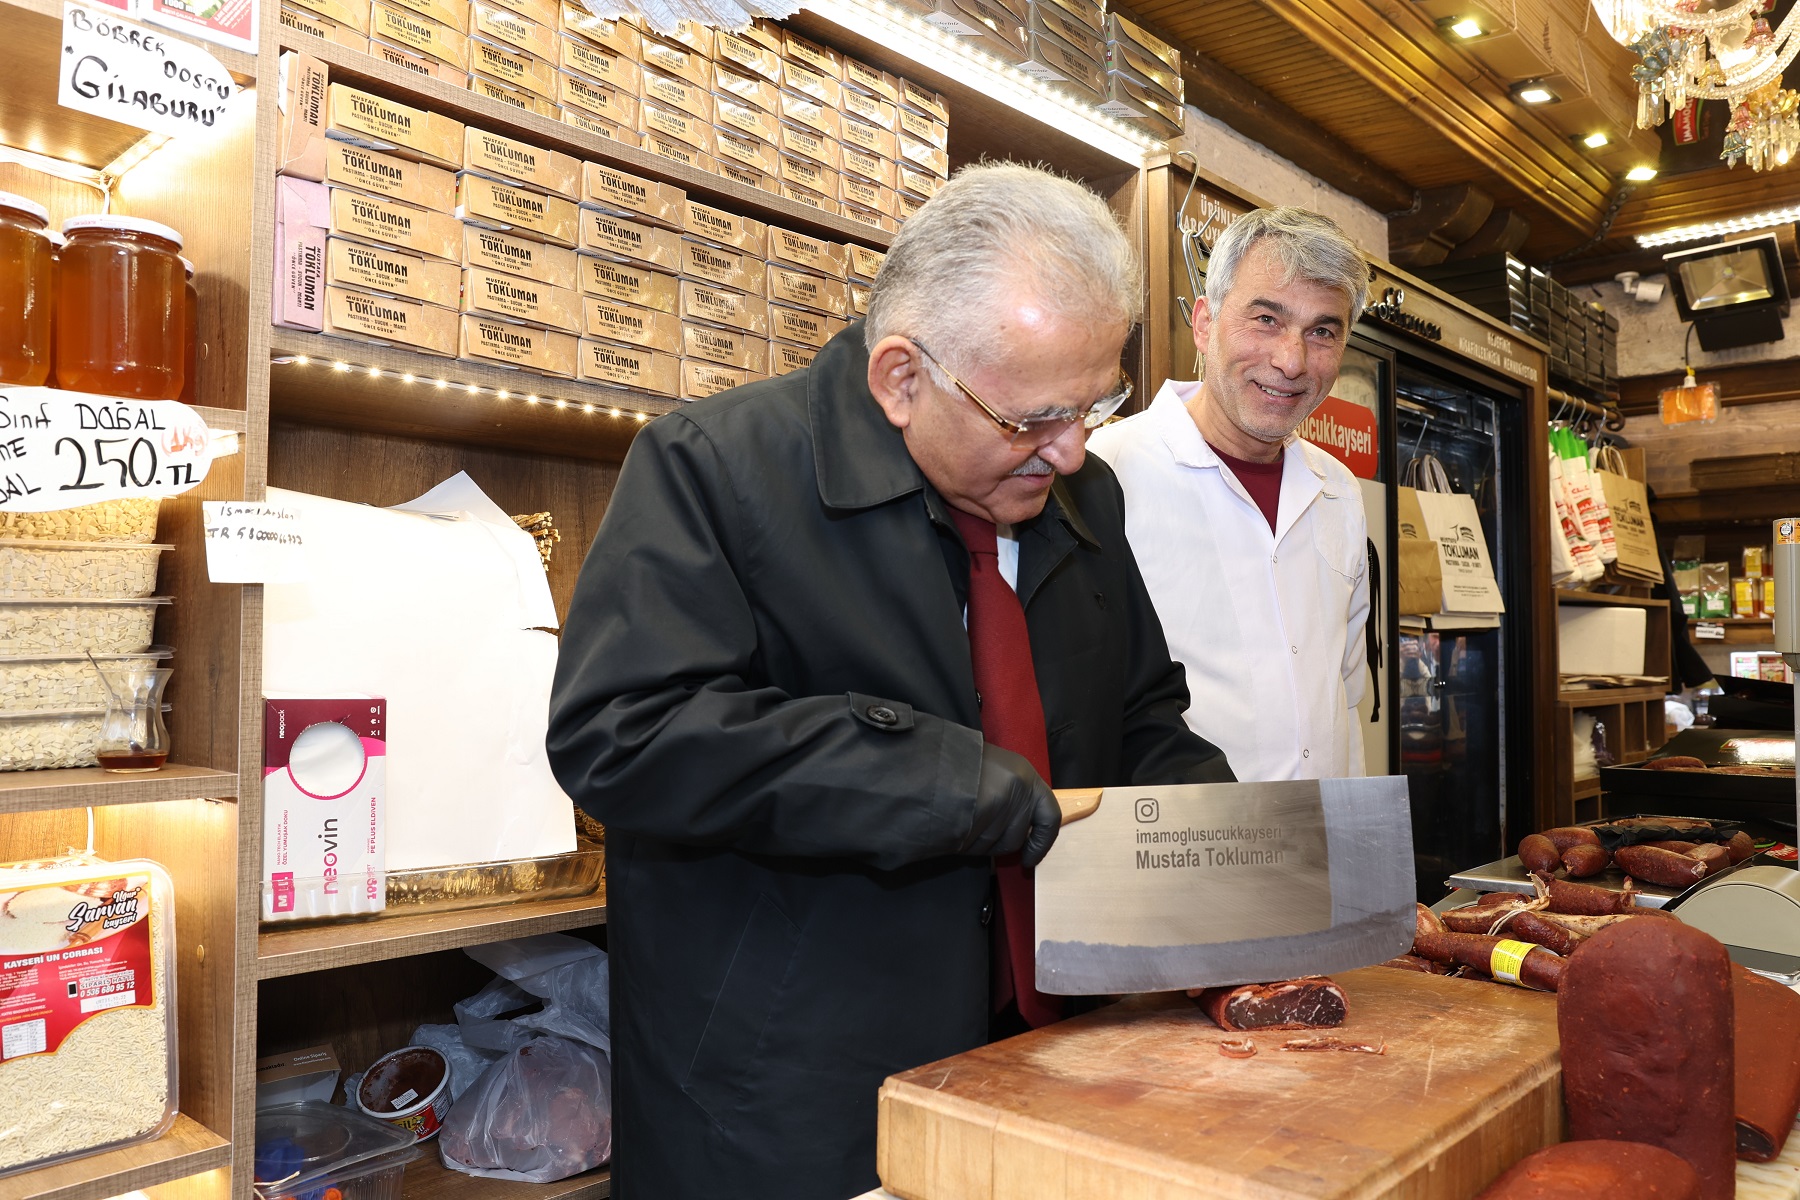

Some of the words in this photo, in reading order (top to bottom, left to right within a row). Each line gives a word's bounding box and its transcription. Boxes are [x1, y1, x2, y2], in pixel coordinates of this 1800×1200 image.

[280, 14, 324, 38] OKLUMAN
[385, 12, 432, 39] TOKLUMAN
[69, 9, 166, 56] BÖBREK
[164, 60, 230, 99] DOSTU
[383, 48, 405, 59] MUSTAFA
[482, 49, 524, 72] TOKLUMAN
[572, 46, 610, 68] TOKLUMAN
[383, 52, 429, 76] TOKLUMAN
[310, 72, 320, 126] TOKLUMAN
[350, 94, 380, 106] MUSTAFA
[485, 87, 526, 109] TOKLUMAN
[570, 81, 607, 103] TOKLUMAN
[350, 98, 411, 128] TOKLUMAN
[574, 117, 610, 136] TOKLUMAN
[482, 136, 508, 147] MUSTAFA
[342, 148, 371, 160] MUSTAFA
[483, 140, 535, 166] TOKLUMAN
[657, 143, 690, 162] TOKLUMAN
[342, 153, 402, 180] TOKLUMAN
[600, 170, 622, 180] MUSTAFA
[491, 185, 516, 195] MUSTAFA
[600, 174, 646, 198] TOKLUMAN
[351, 198, 380, 210] MUSTAFA
[492, 190, 543, 214] TOKLUMAN
[352, 203, 411, 229] TOKLUMAN
[596, 217, 617, 226] MUSTAFA
[691, 210, 732, 230] TOKLUMAN
[480, 234, 504, 243] MUSTAFA
[596, 222, 642, 243] TOKLUMAN
[348, 248, 377, 258] MUSTAFA
[480, 238, 532, 261] TOKLUMAN
[782, 236, 818, 254] TOKLUMAN
[348, 252, 408, 277] TOKLUMAN
[593, 263, 615, 271] MUSTAFA
[691, 250, 731, 270] TOKLUMAN
[304, 246, 316, 311] TOKLUMAN
[486, 277, 511, 286] MUSTAFA
[594, 267, 639, 288] TOKLUMAN
[346, 295, 375, 305] MUSTAFA
[486, 282, 538, 304] TOKLUMAN
[346, 299, 406, 324] TOKLUMAN
[598, 310, 642, 328] TOKLUMAN
[479, 323, 504, 332] MUSTAFA
[783, 316, 818, 331] TOKLUMAN
[480, 328, 532, 348] TOKLUMAN
[693, 332, 734, 350] TOKLUMAN
[594, 351, 639, 370] TOKLUMAN
[74, 402, 166, 430] DOĞAL
[207, 527, 230, 539] TR
[1442, 544, 1480, 560] TOKLUMAN
[278, 709, 286, 738] neopack
[1136, 826, 1282, 846] imamoglusucukkayseri
[370, 845, 376, 854] PE
[1136, 849, 1200, 870] Mustafa
[1204, 846, 1284, 866] Tokluman
[46, 954, 60, 962] UN
[62, 946, 103, 960] ÇORBASI
